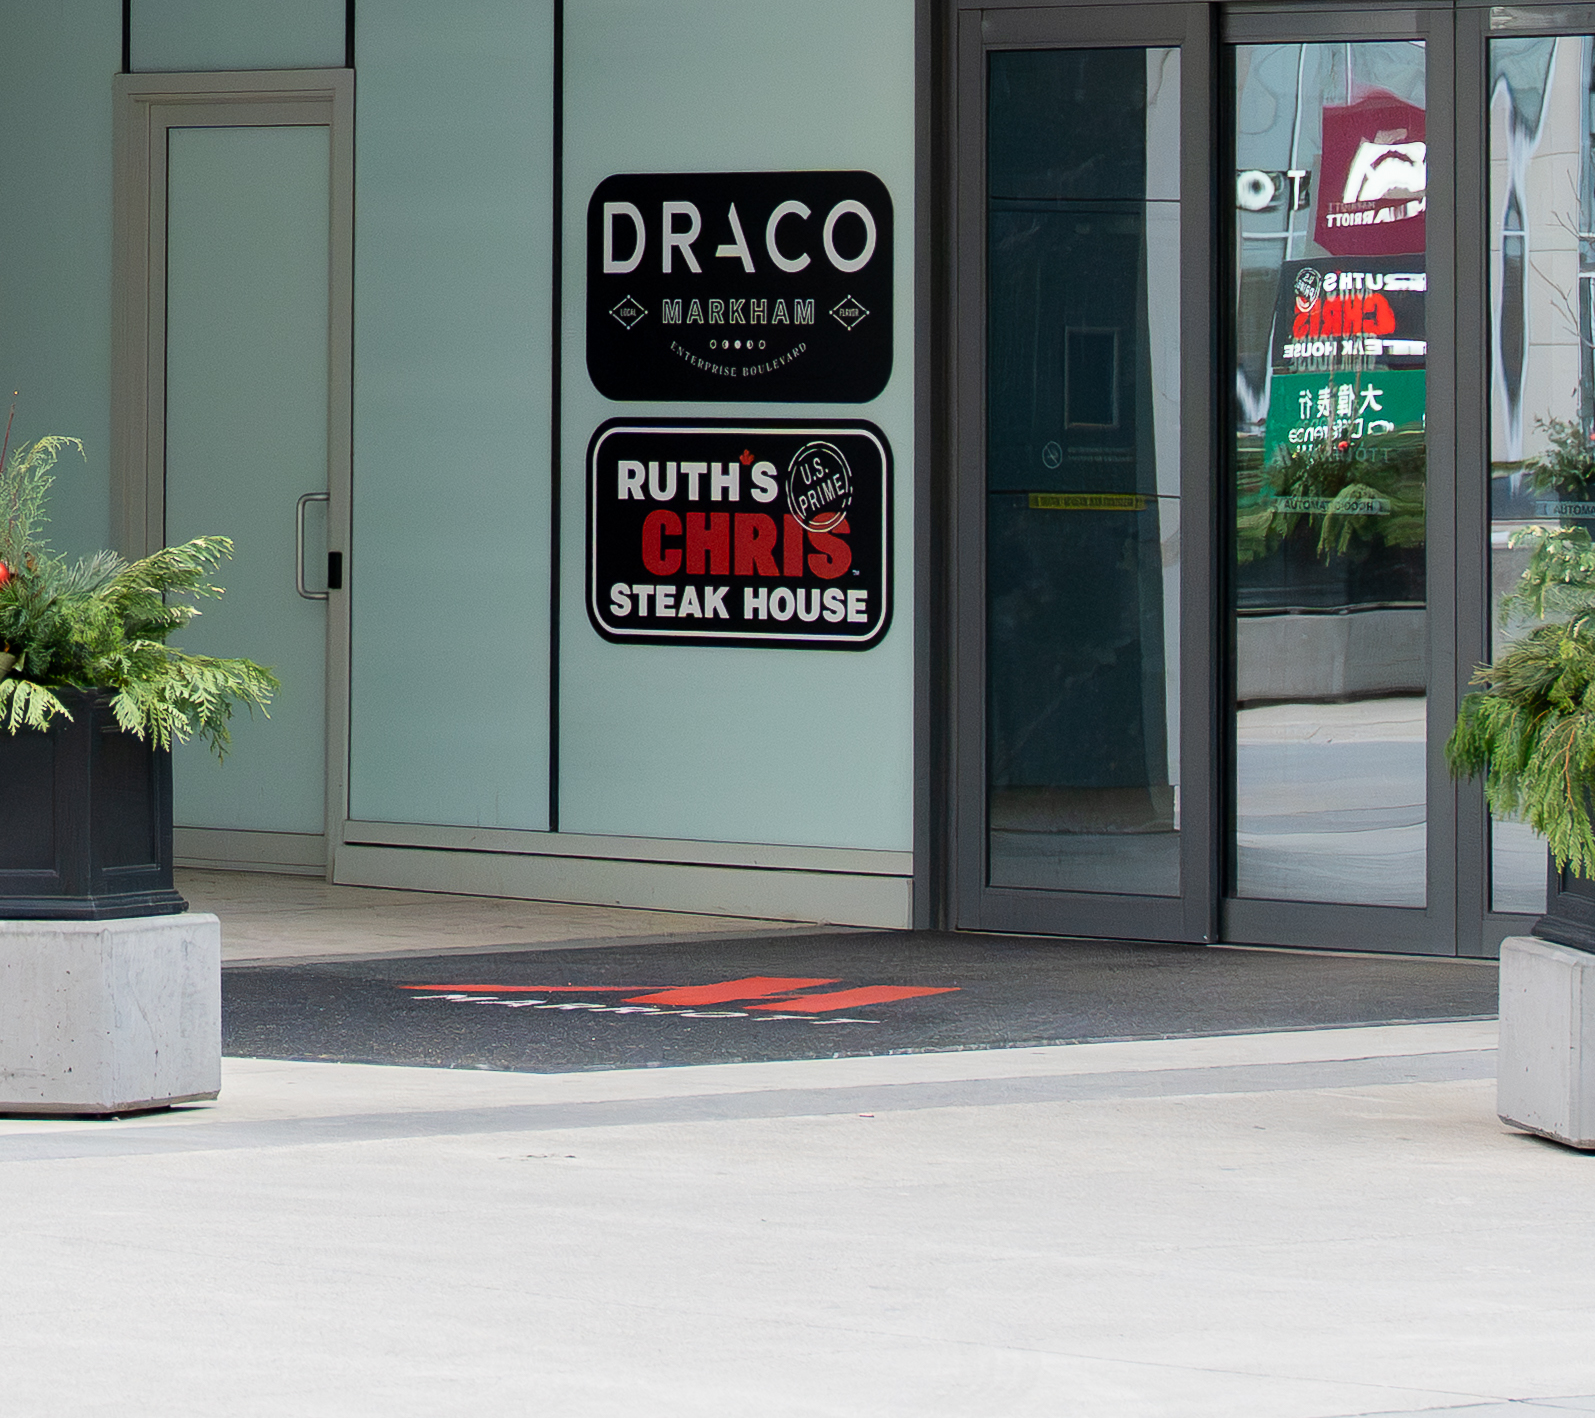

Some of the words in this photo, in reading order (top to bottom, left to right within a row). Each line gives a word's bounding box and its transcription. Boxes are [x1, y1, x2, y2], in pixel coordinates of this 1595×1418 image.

[602, 200, 877, 274] DRACO
[662, 299, 816, 325] MARKHAM
[669, 340, 738, 378] ENTERPRISE
[741, 341, 808, 378] BOULEVARD
[800, 456, 830, 486] U.S.
[798, 472, 846, 516] PRIME
[641, 509, 853, 581] CHRIS
[609, 583, 730, 619] STEAK
[742, 587, 869, 623] HOUSE
